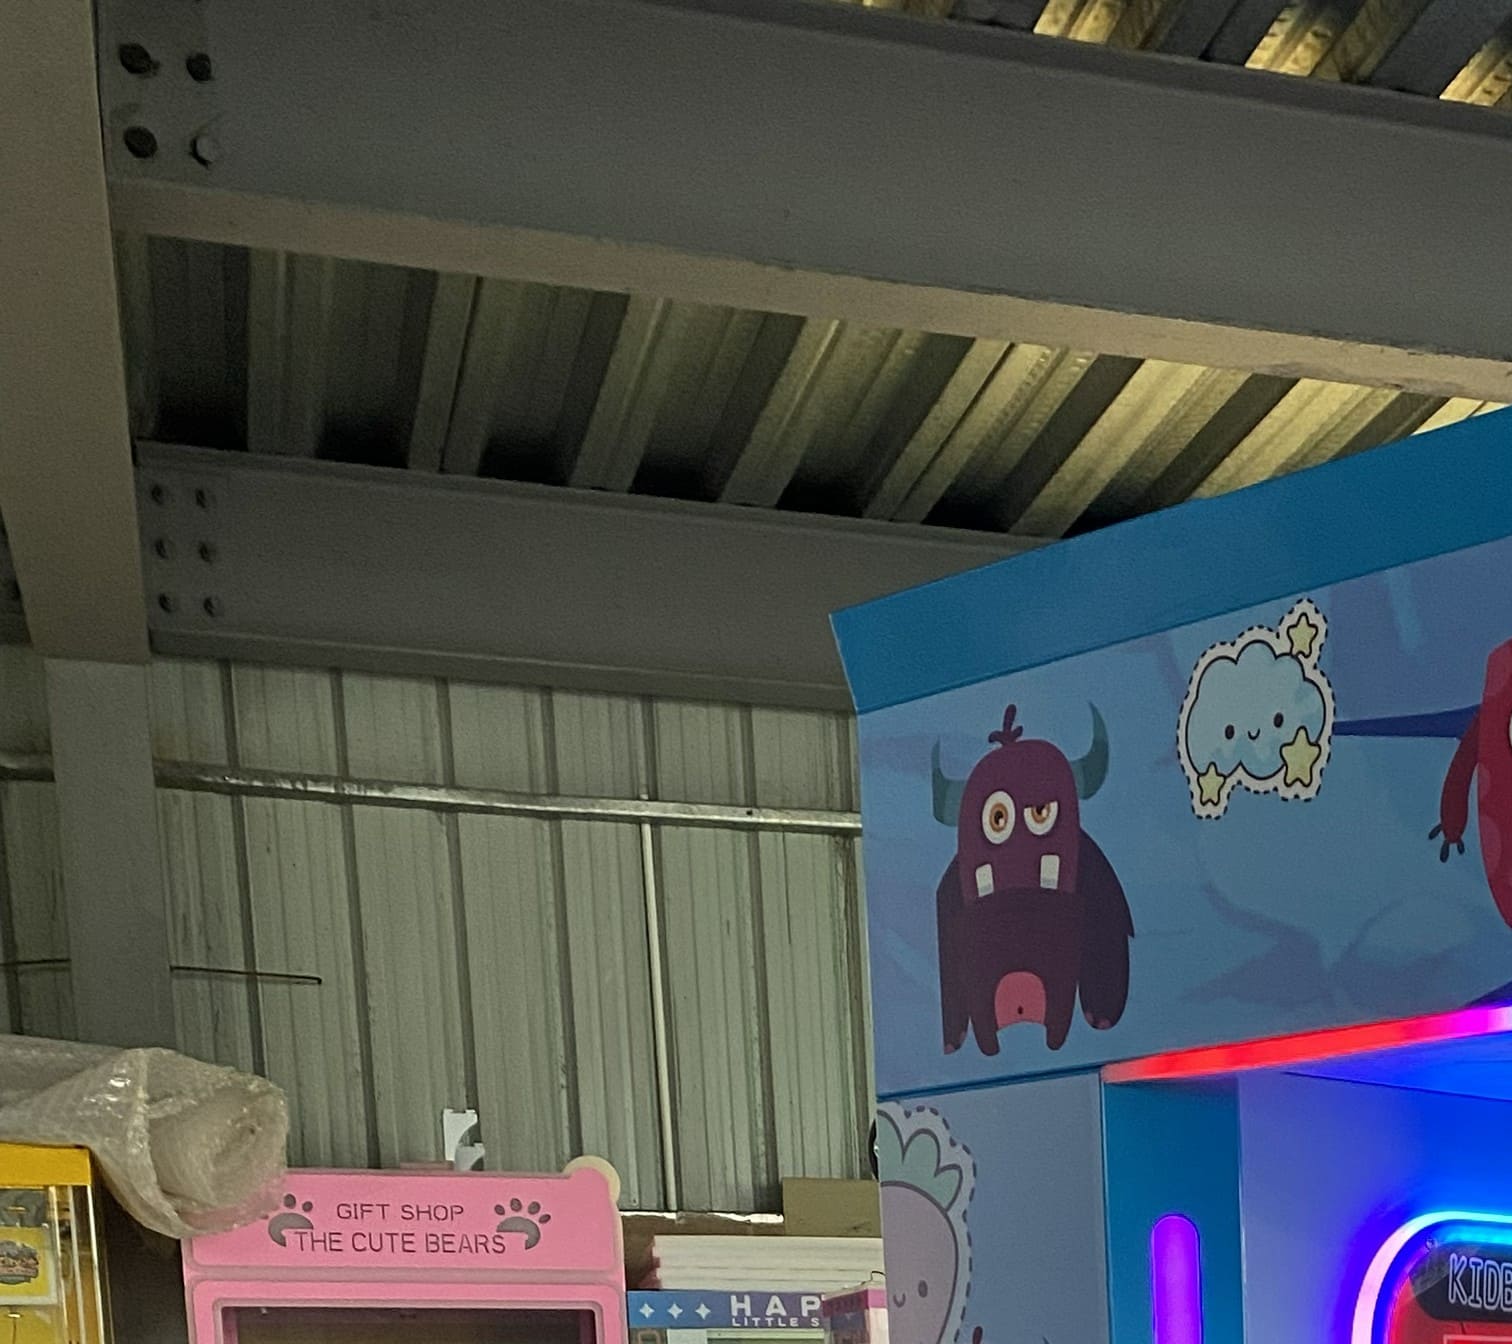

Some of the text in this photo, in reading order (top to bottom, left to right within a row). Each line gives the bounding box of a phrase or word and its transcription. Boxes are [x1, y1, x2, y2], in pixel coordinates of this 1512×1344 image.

[337, 1203, 464, 1221] GIFT SHOP
[294, 1231, 506, 1254] THE CUTE BEARS
[732, 1317, 799, 1327] LITTLE
